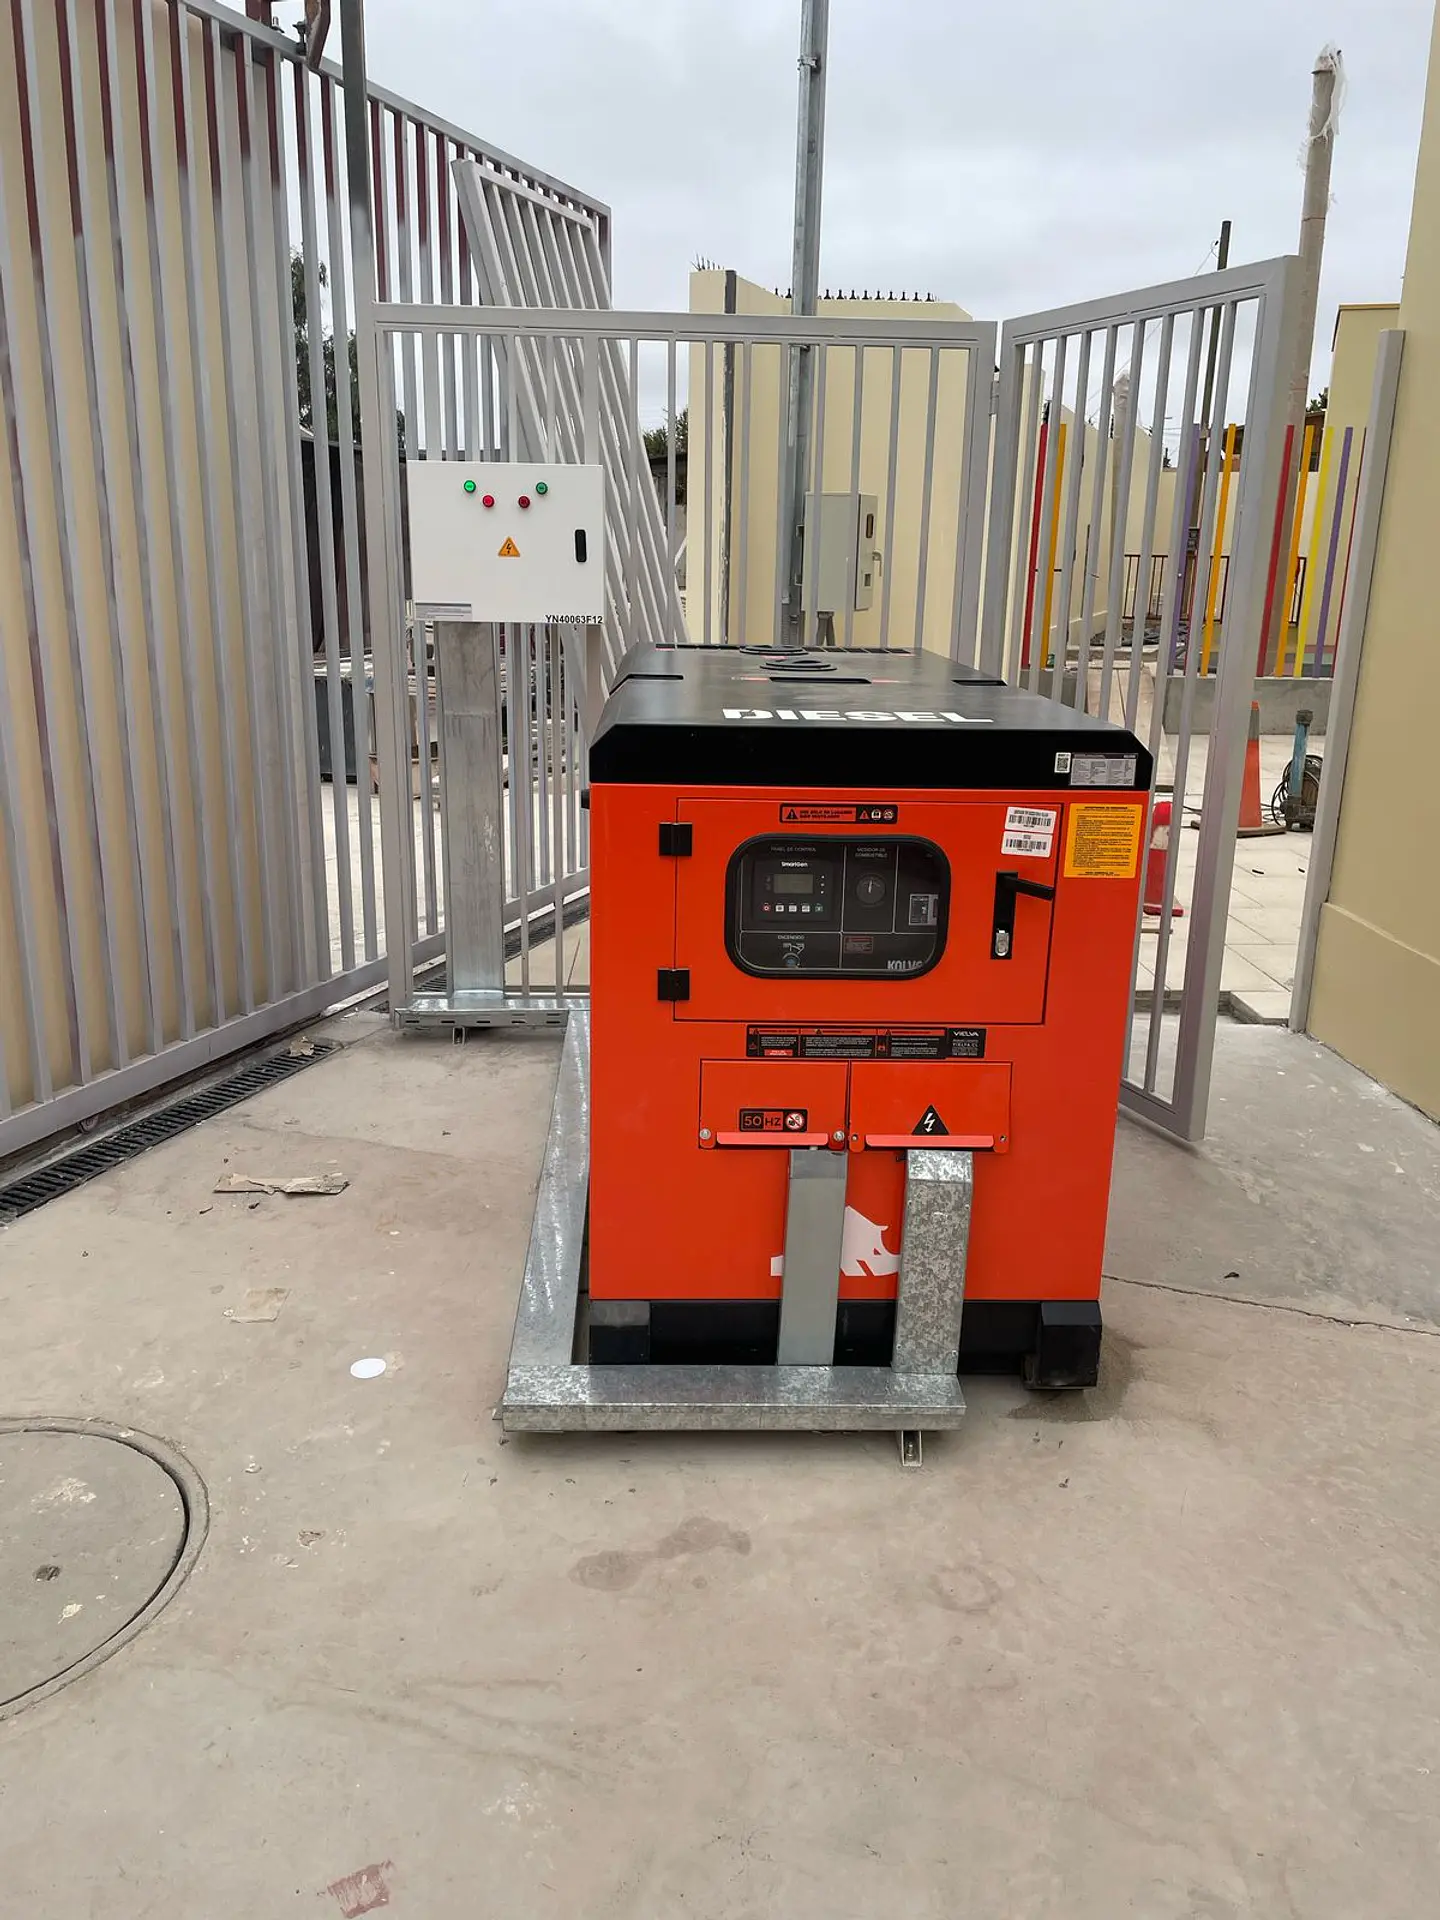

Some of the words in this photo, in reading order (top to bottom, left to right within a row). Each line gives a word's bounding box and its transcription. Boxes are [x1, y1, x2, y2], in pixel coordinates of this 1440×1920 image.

[545, 614, 603, 624] YN40063F12
[722, 708, 994, 723] DIESEL
[744, 1115, 762, 1126] 50
[765, 1117, 781, 1126] HZ
